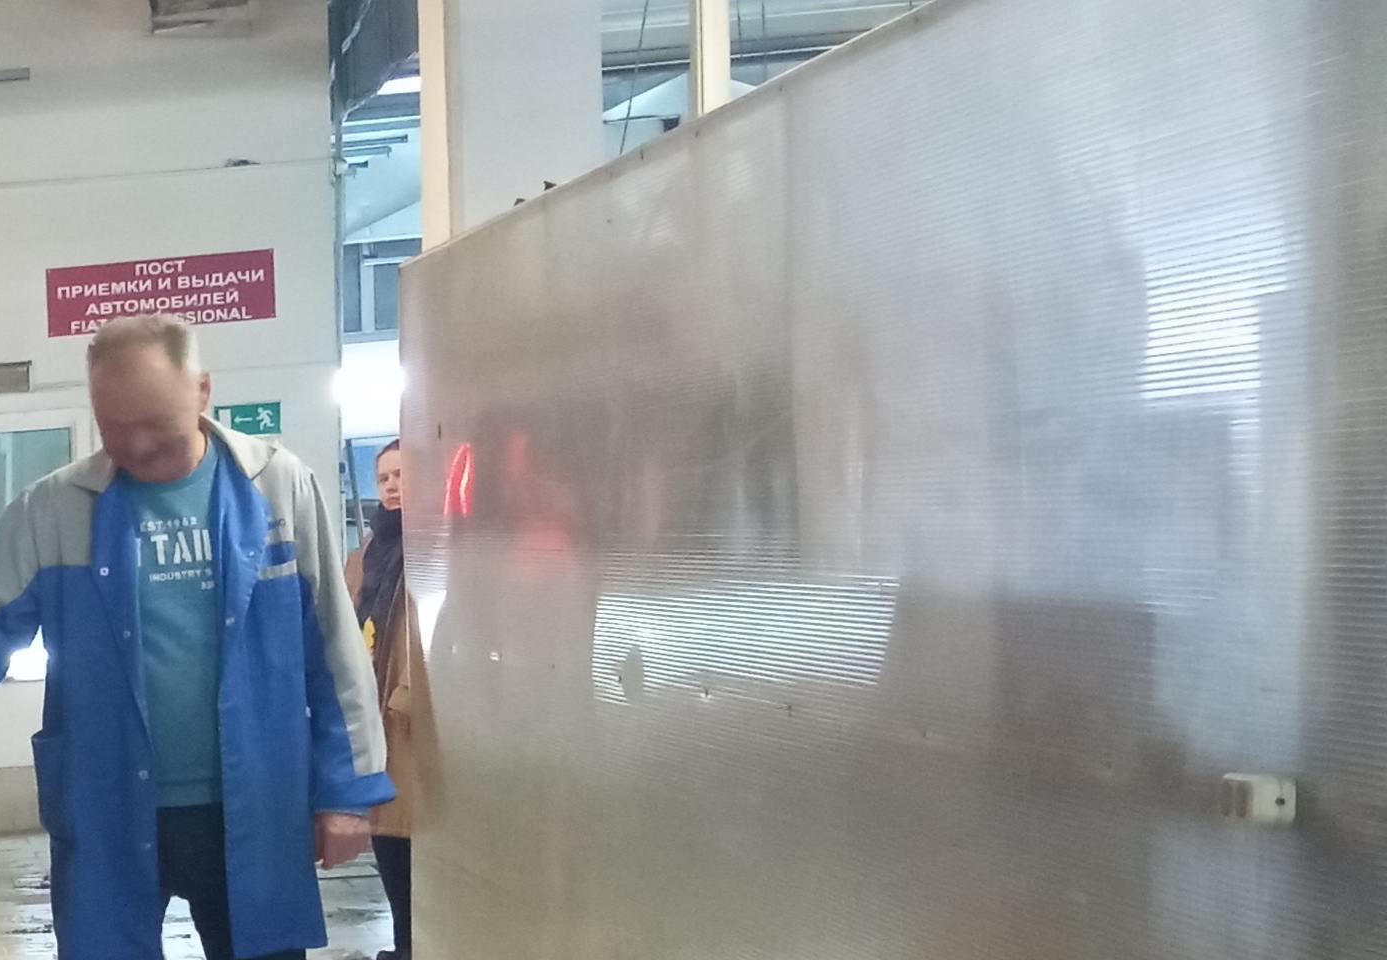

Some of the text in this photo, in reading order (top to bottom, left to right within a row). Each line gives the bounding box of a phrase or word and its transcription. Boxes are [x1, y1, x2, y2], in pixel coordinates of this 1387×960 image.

[134, 259, 186, 276] ПОСТ
[57, 268, 265, 300] ПРИЕМКИ И ВЫДАЧИ
[85, 288, 240, 316] АВТОМОБИЛЕЙ
